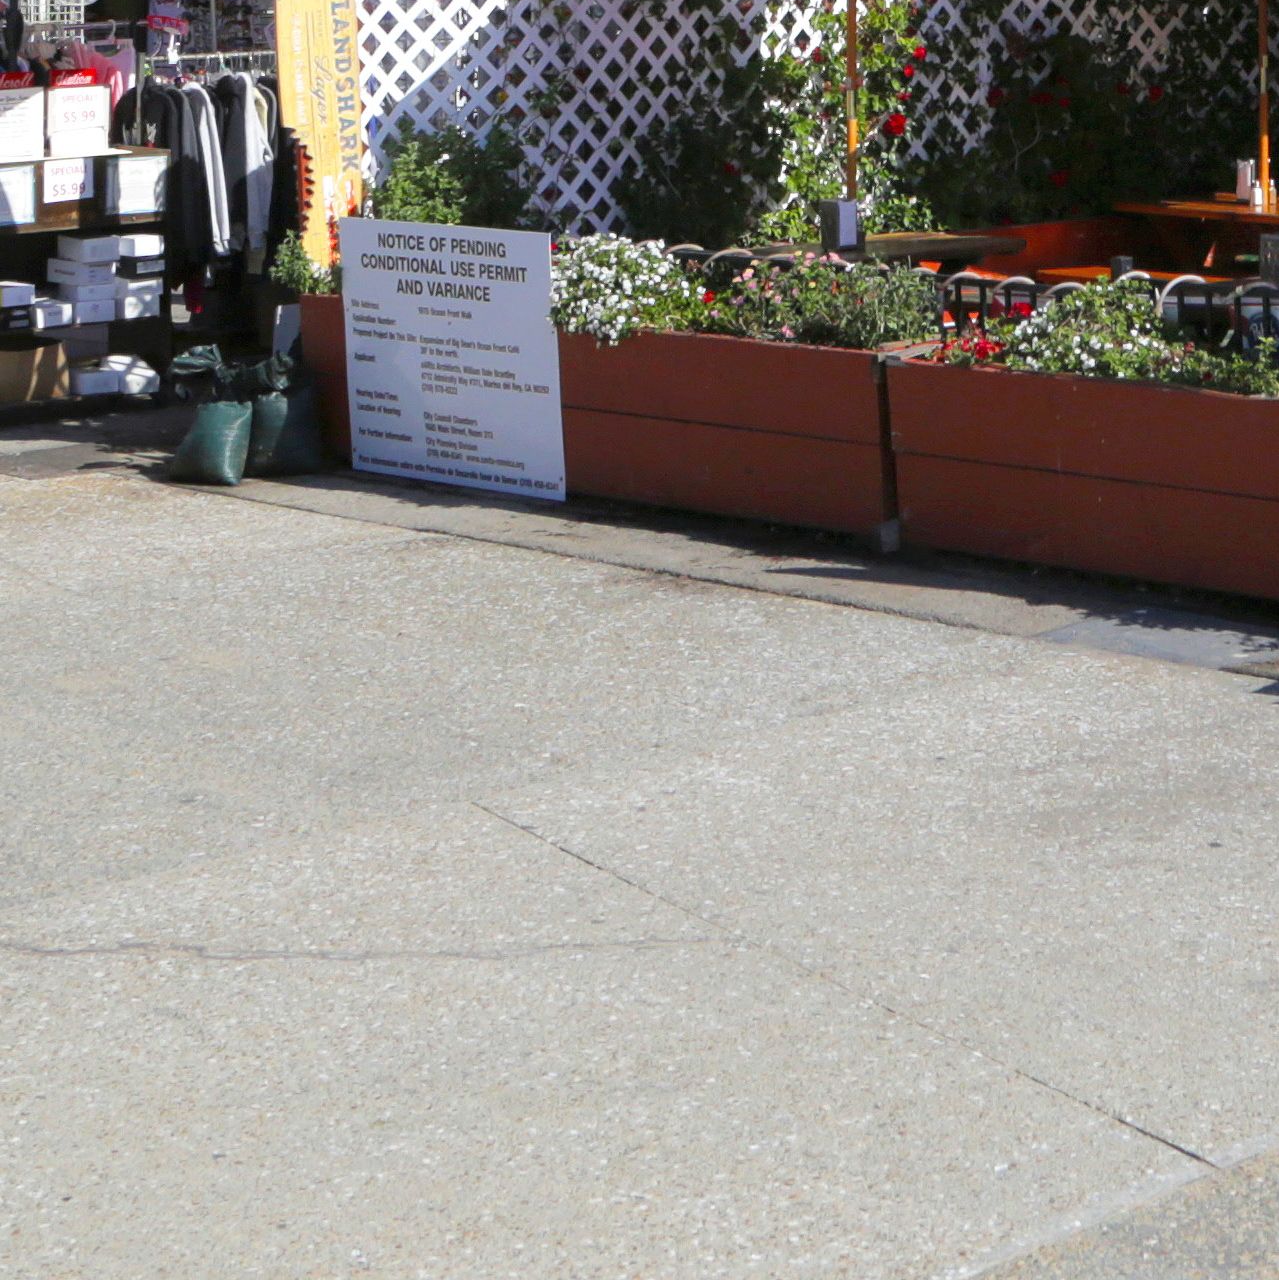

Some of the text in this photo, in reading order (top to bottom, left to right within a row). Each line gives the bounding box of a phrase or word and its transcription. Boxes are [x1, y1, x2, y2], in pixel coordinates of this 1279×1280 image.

[331, 0, 359, 173] LANDSHARK
[52, 182, 86, 197] $5.99
[378, 233, 506, 258] NOTICE OF PENDING
[361, 253, 528, 283] CONDITIONAL USE PERMIT
[396, 279, 491, 302] AND VARIANCE
